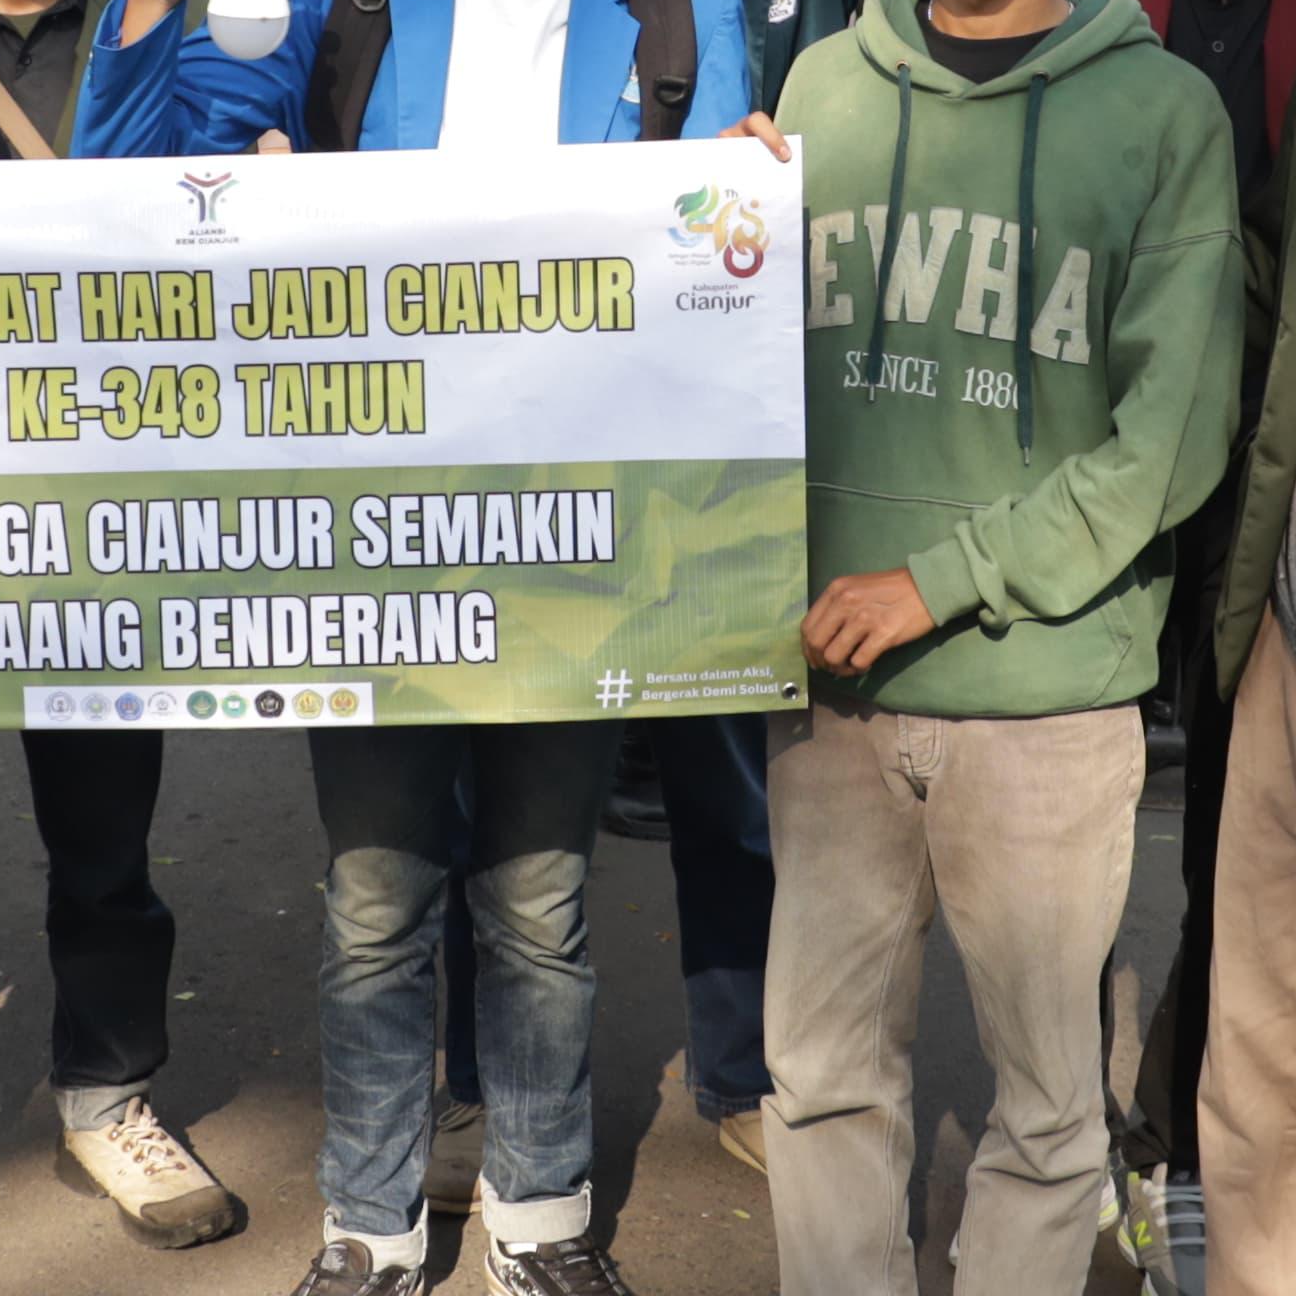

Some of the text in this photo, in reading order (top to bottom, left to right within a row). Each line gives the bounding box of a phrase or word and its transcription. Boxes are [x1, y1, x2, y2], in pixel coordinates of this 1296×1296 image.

[78, 270, 216, 342] HARI
[232, 265, 369, 341] JADI
[384, 256, 635, 336] CIANJUR
[675, 290, 756, 314] Cianjur
[805, 203, 1092, 366] EWHA
[6, 360, 426, 442] KE-348 TAHUN
[87, 497, 334, 574] CIANJUR
[350, 489, 616, 569] SEMAKIN
[160, 590, 498, 671] BENDERANG
[642, 683, 779, 702] Bergerak Demi Solusi
[646, 666, 774, 684] Bersatu dalam Aksi,
